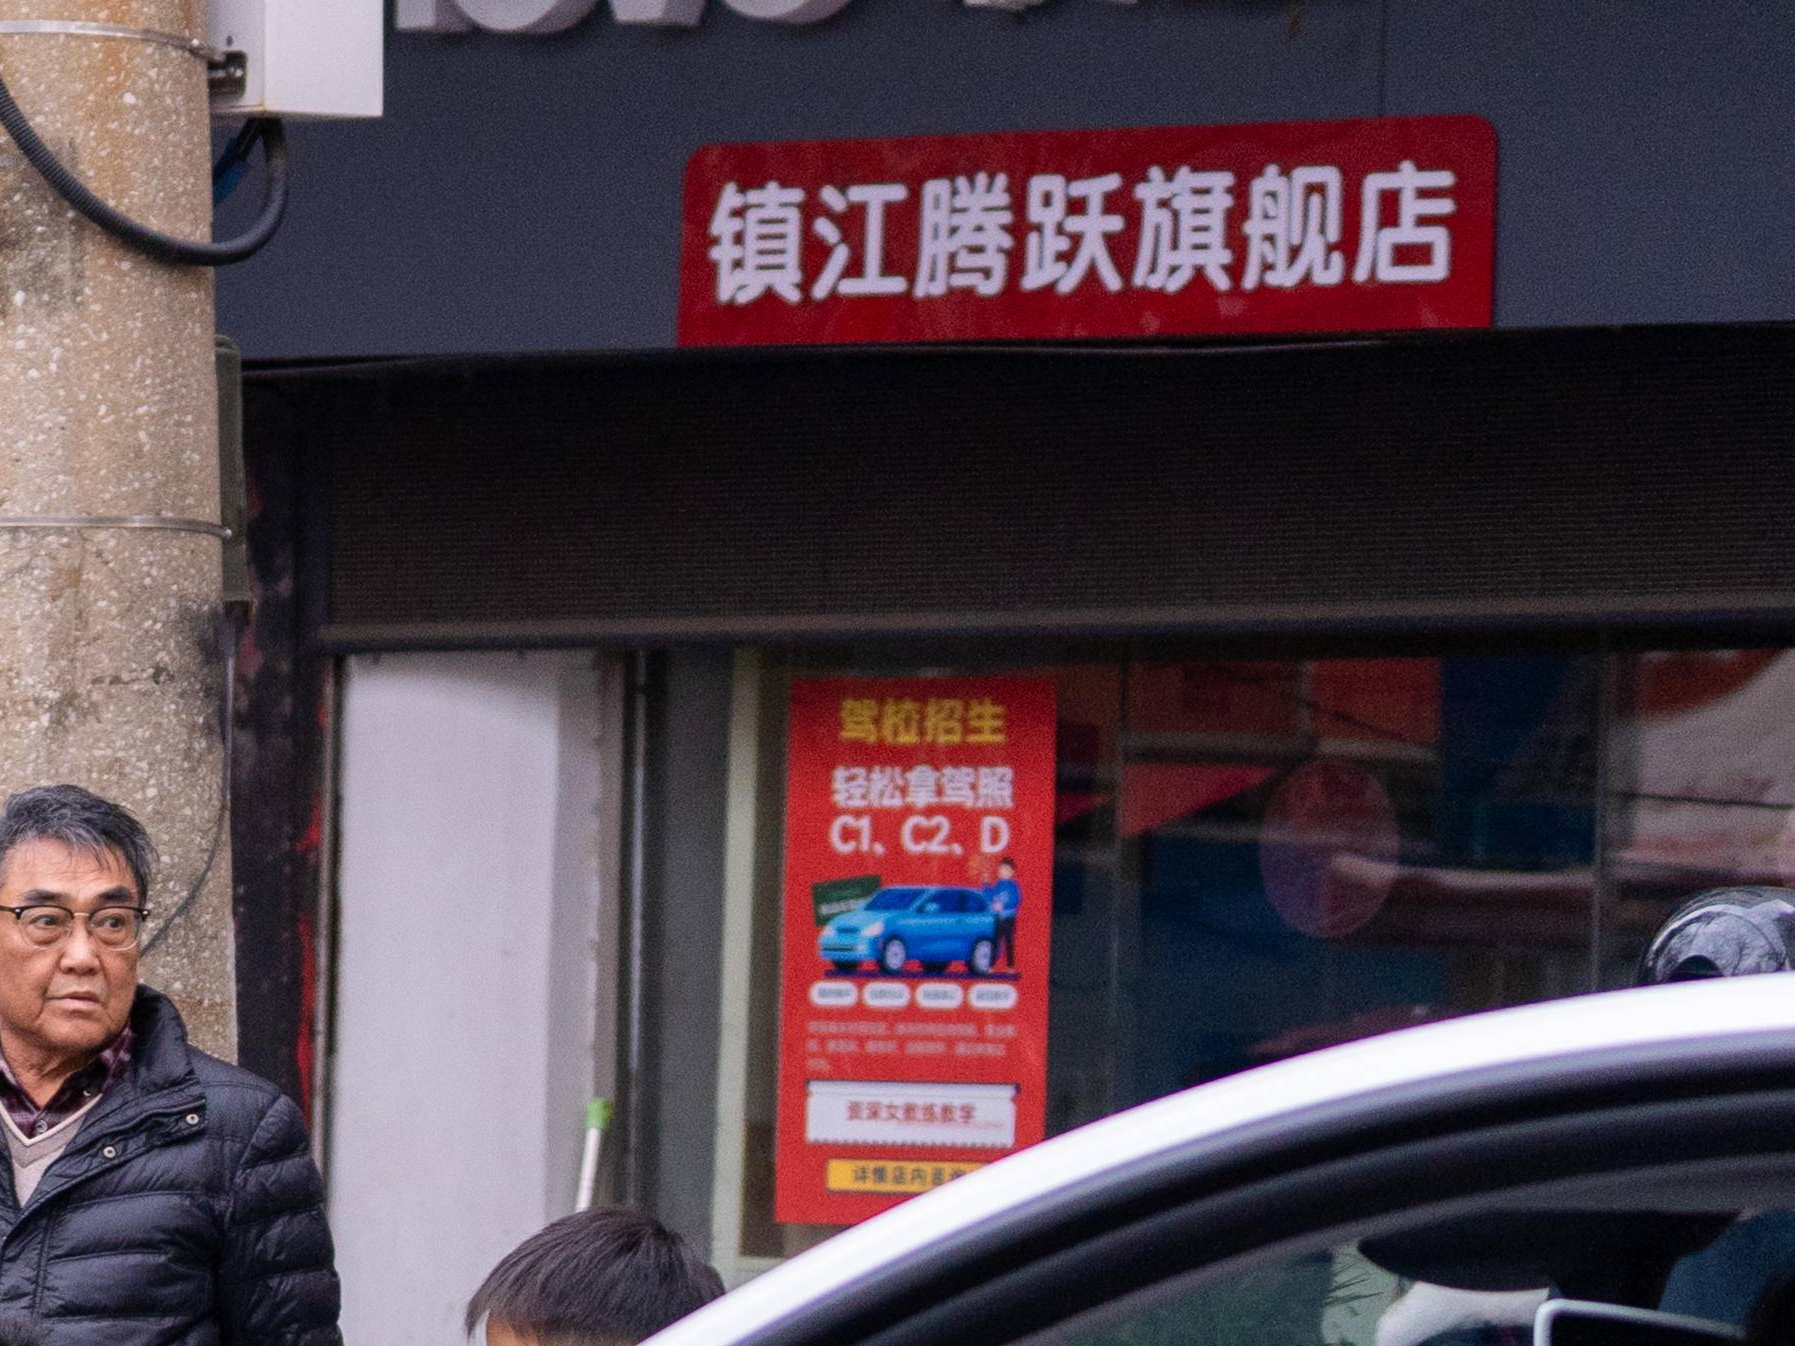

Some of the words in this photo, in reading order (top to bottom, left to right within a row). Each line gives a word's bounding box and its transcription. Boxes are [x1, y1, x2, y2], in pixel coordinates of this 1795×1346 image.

[706, 157, 1459, 307] 镇江腾跃旗舰店
[838, 696, 1008, 744] 驾校招生
[831, 764, 1015, 809] 轻松拿驾照
